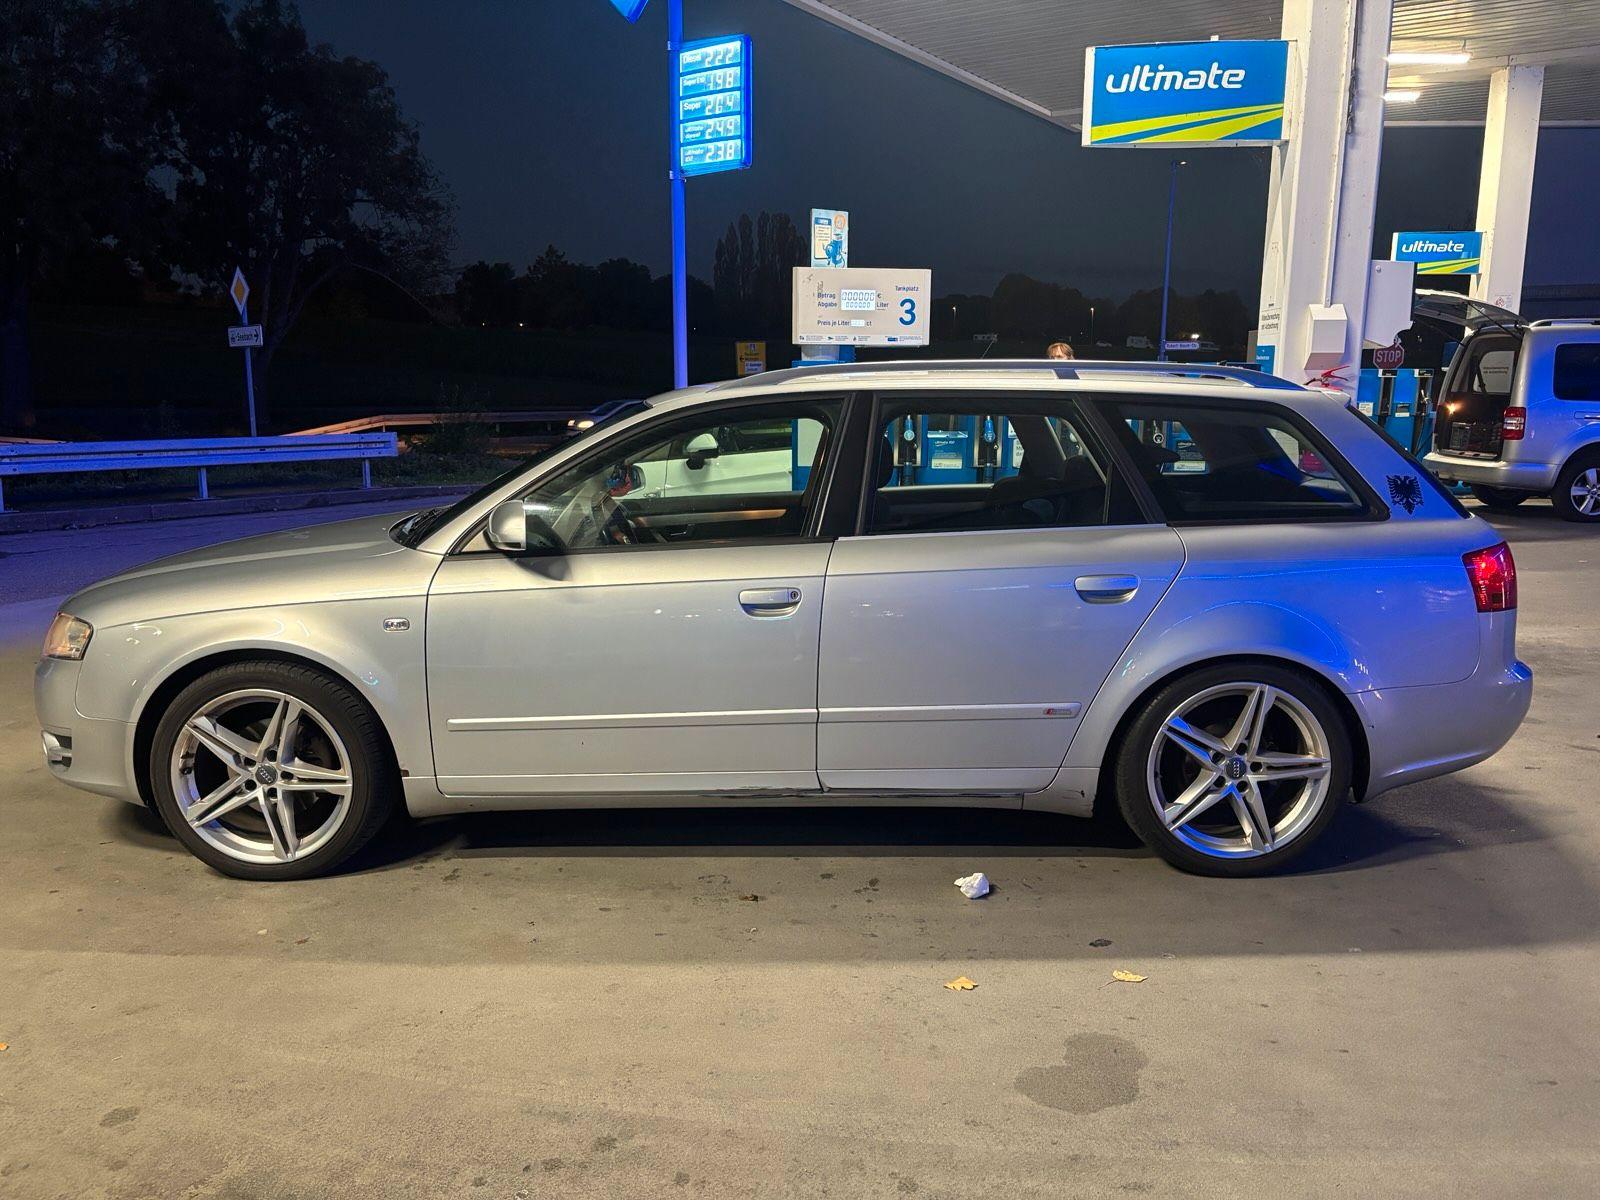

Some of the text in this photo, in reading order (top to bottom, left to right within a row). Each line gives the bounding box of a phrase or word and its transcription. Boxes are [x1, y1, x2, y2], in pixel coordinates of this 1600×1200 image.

[1105, 62, 1246, 93] ultimate
[683, 102, 701, 112] Super
[1402, 240, 1464, 253] ultimate
[899, 298, 916, 326] 3
[1377, 350, 1401, 362] STOP
